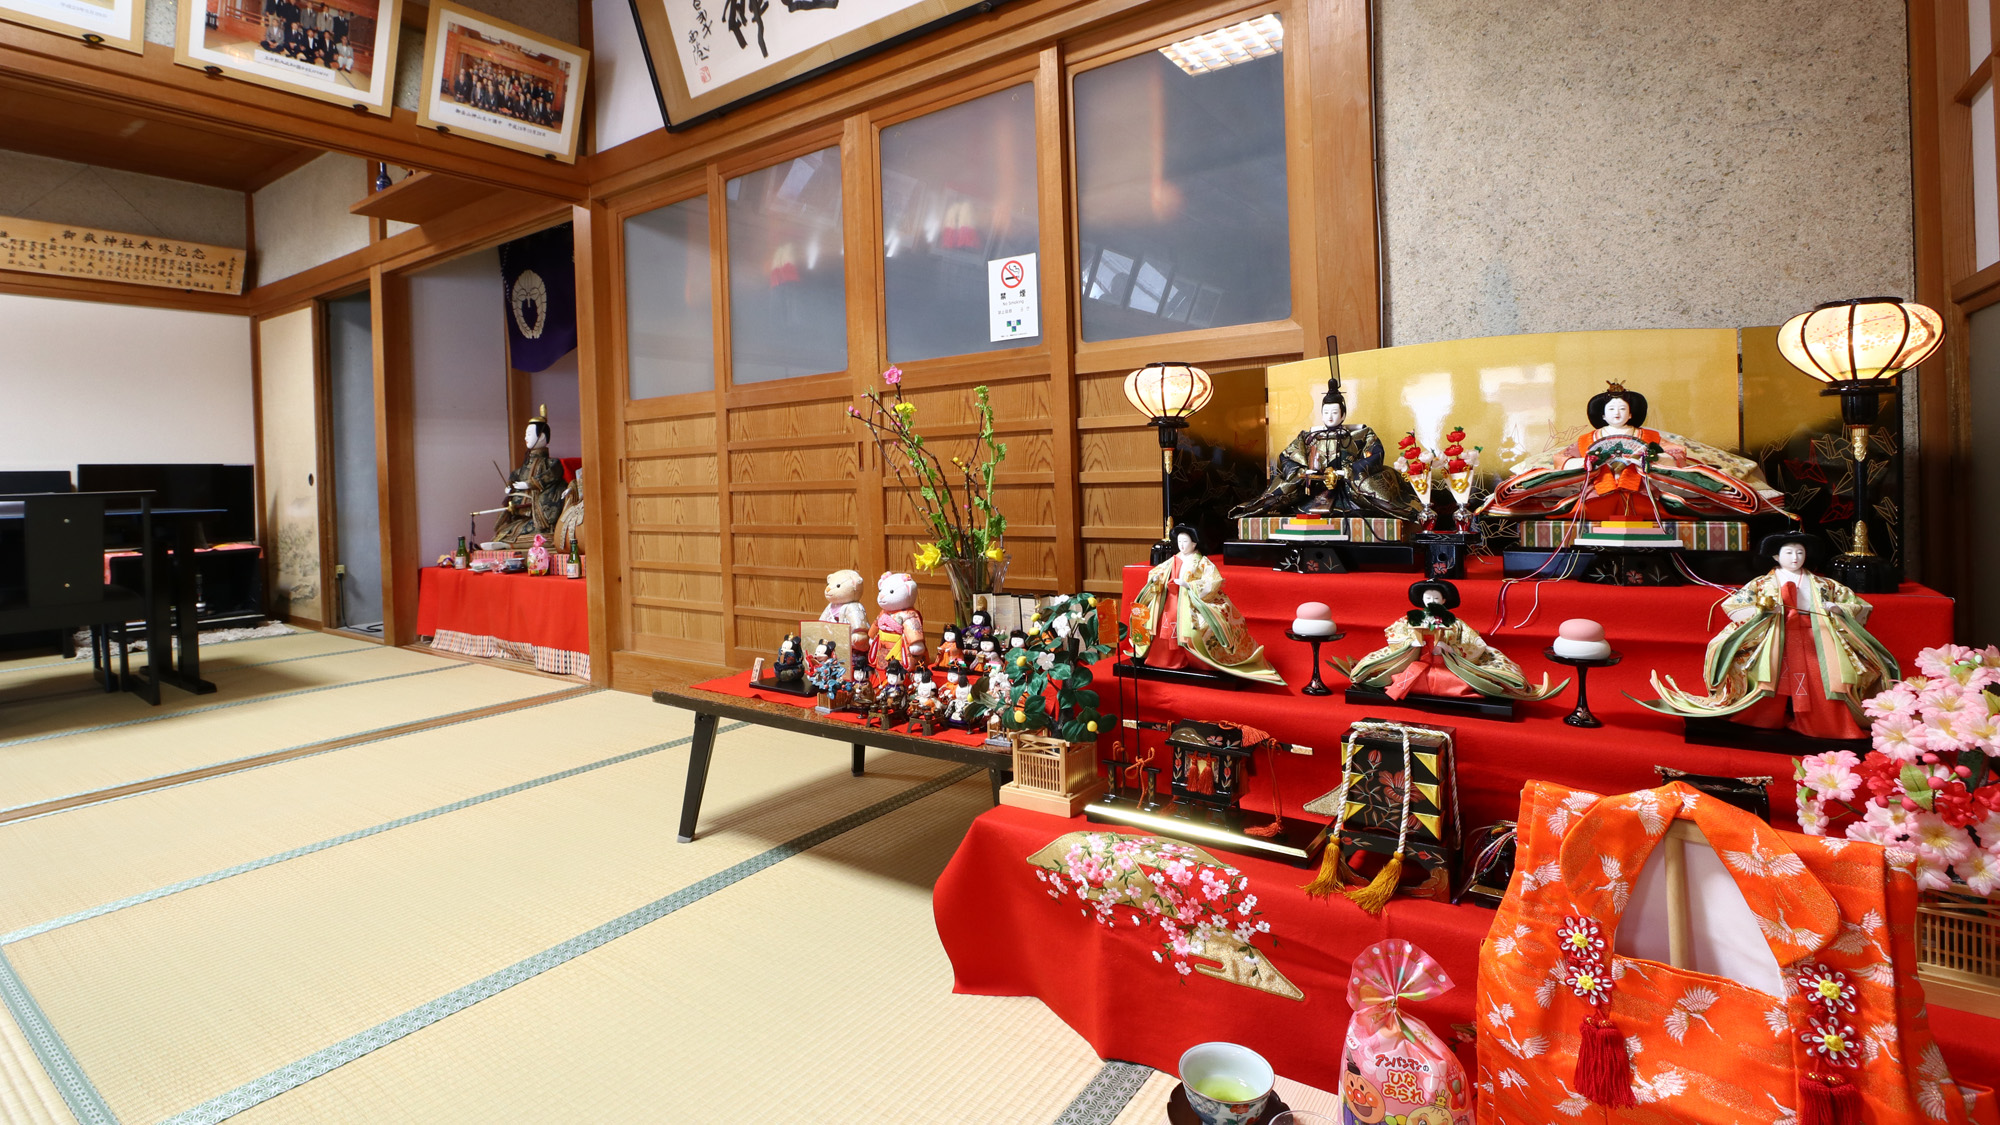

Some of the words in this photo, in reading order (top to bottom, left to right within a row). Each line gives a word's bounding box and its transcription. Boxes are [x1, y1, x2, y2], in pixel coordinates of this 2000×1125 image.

[1375, 1053, 1430, 1072] アンパンマンの
[1389, 1071, 1417, 1087] ひな
[1382, 1083, 1426, 1105] あられ
